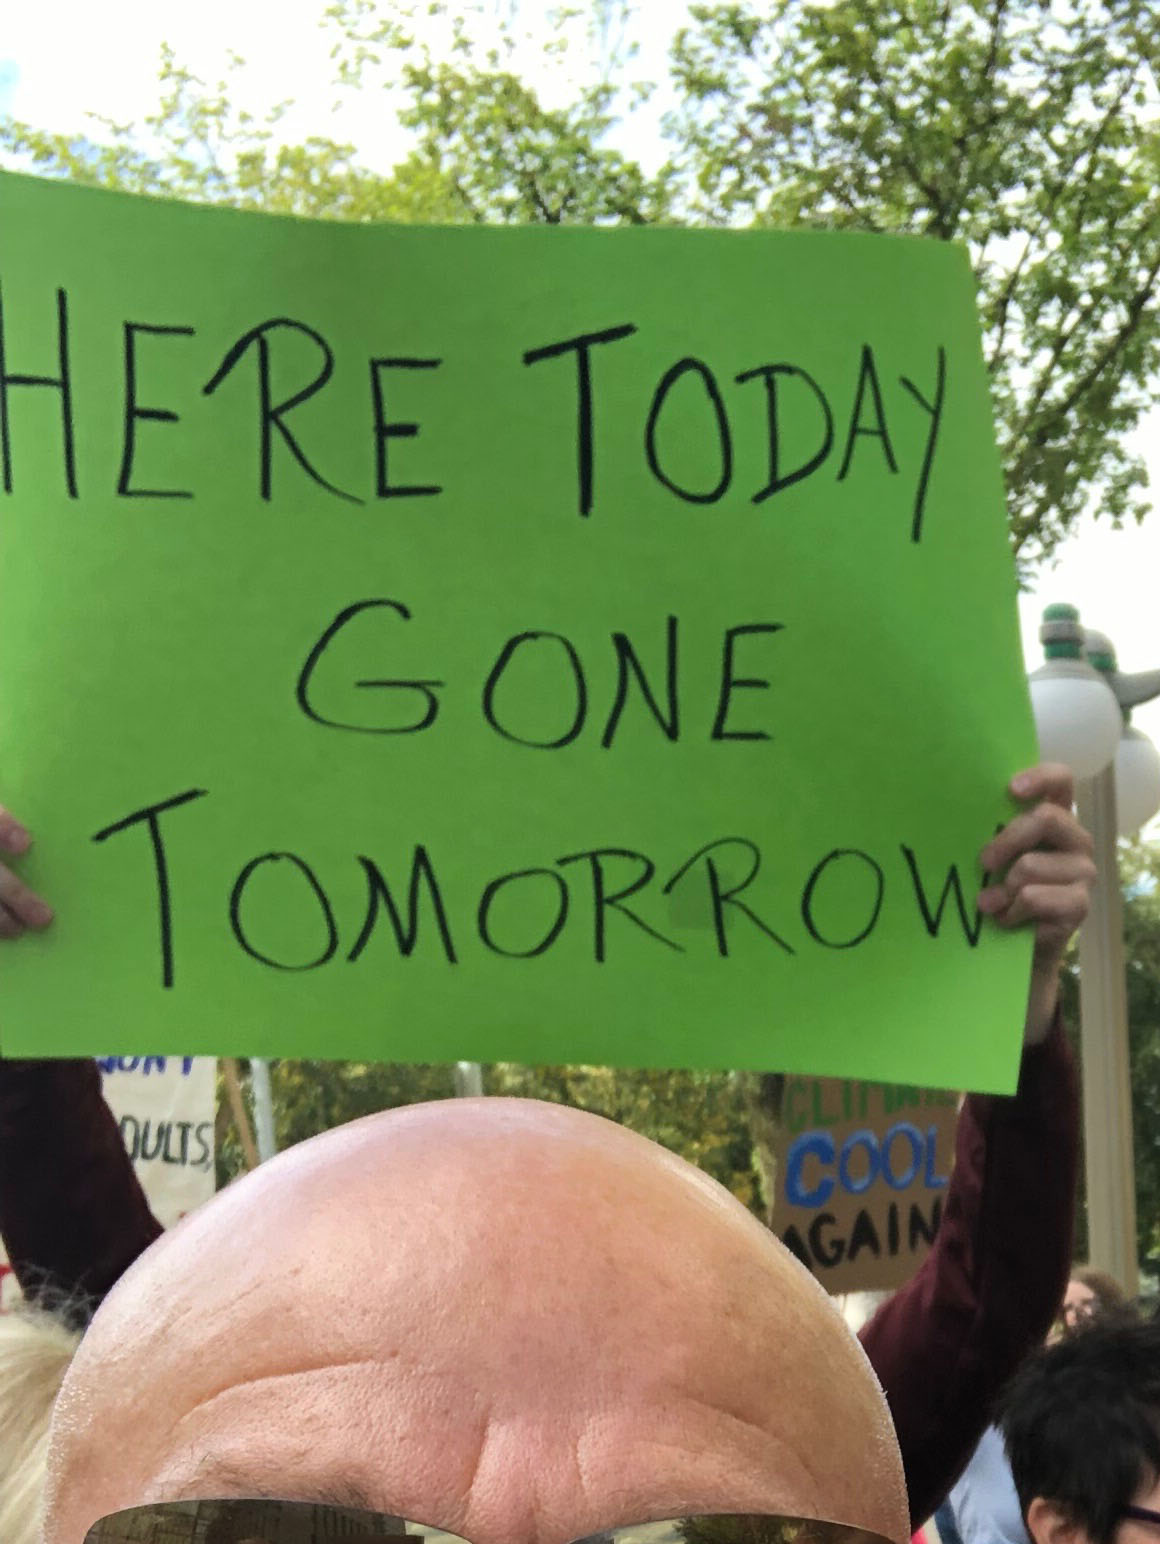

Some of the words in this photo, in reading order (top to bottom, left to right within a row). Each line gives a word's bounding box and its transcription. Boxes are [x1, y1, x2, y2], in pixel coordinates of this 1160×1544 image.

[0, 282, 443, 505] HERE
[523, 323, 946, 543] TODAY
[296, 598, 786, 749] GONE
[91, 787, 1003, 989] TOMORROW
[783, 1194, 943, 1269] AGAIN
[784, 1120, 949, 1209] COOL
